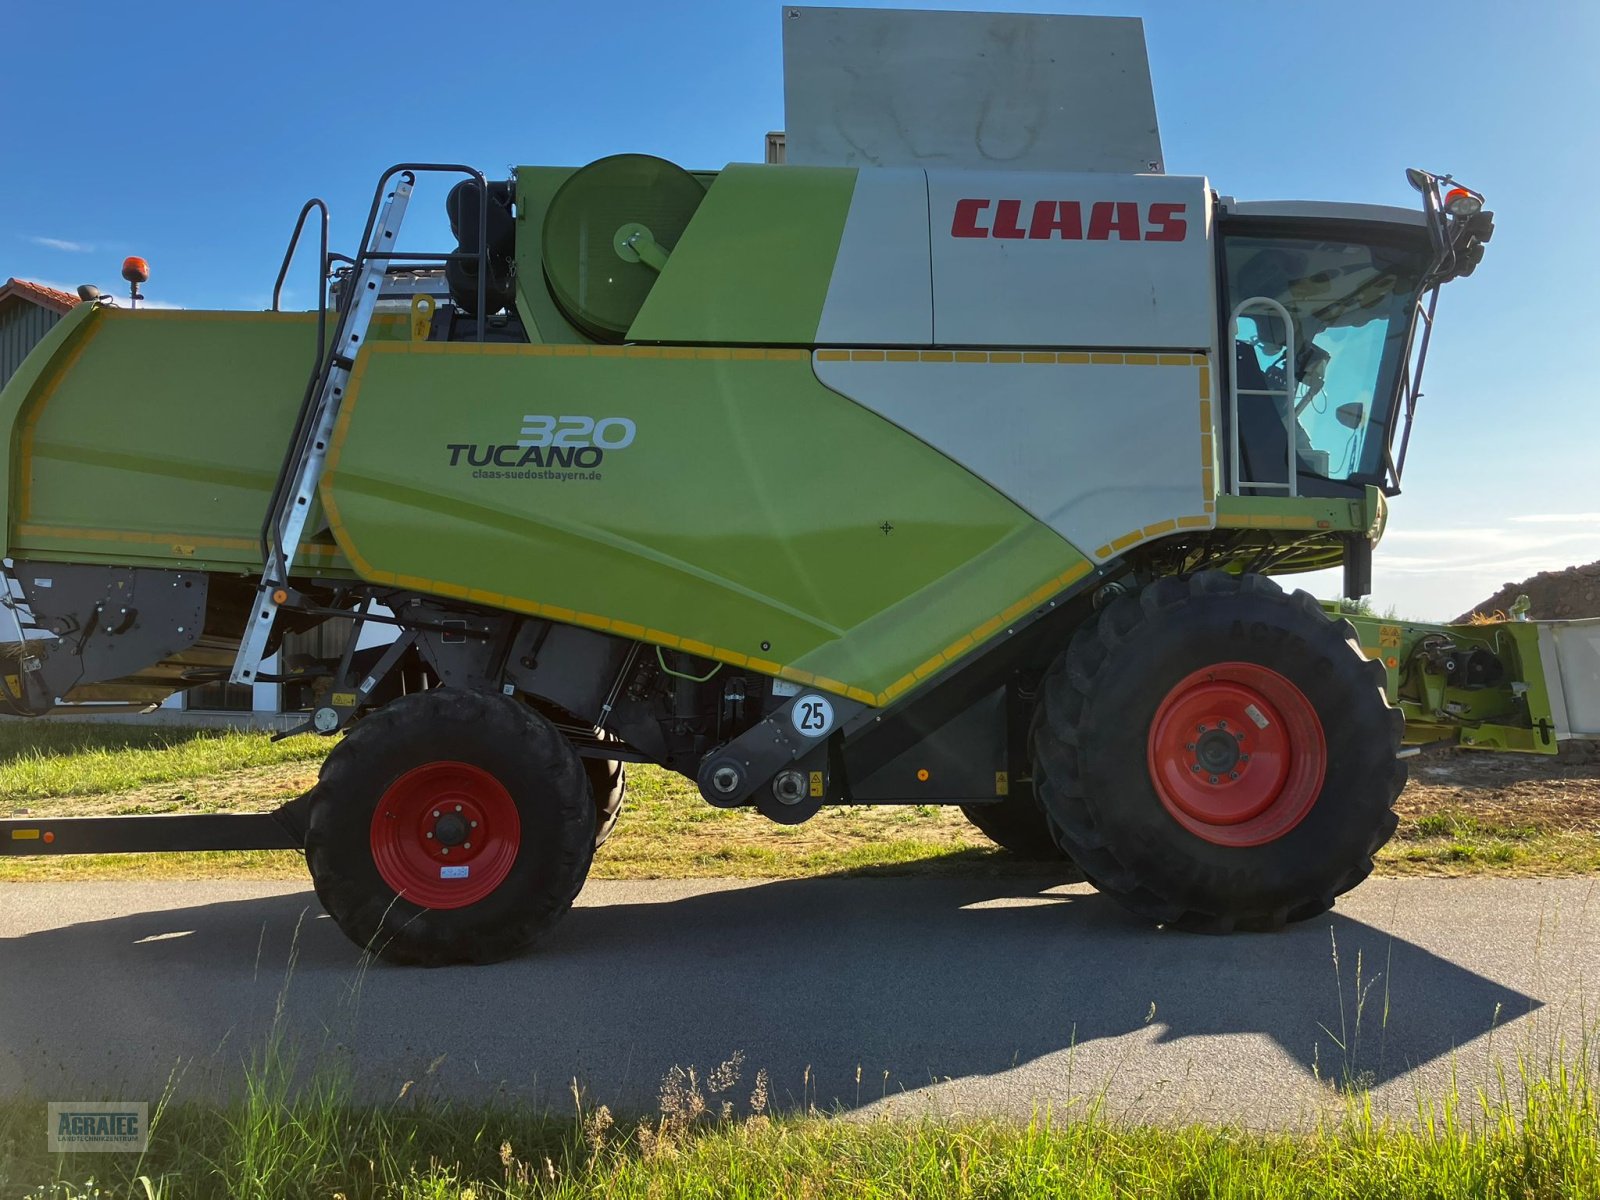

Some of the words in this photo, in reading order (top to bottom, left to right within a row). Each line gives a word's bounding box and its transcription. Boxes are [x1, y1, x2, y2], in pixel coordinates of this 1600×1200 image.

[951, 199, 1187, 242] CLAAS
[517, 415, 637, 450] 320
[447, 444, 604, 468] TUCANO
[472, 468, 602, 482] claas-suedostbayern.de
[801, 702, 825, 730] 25
